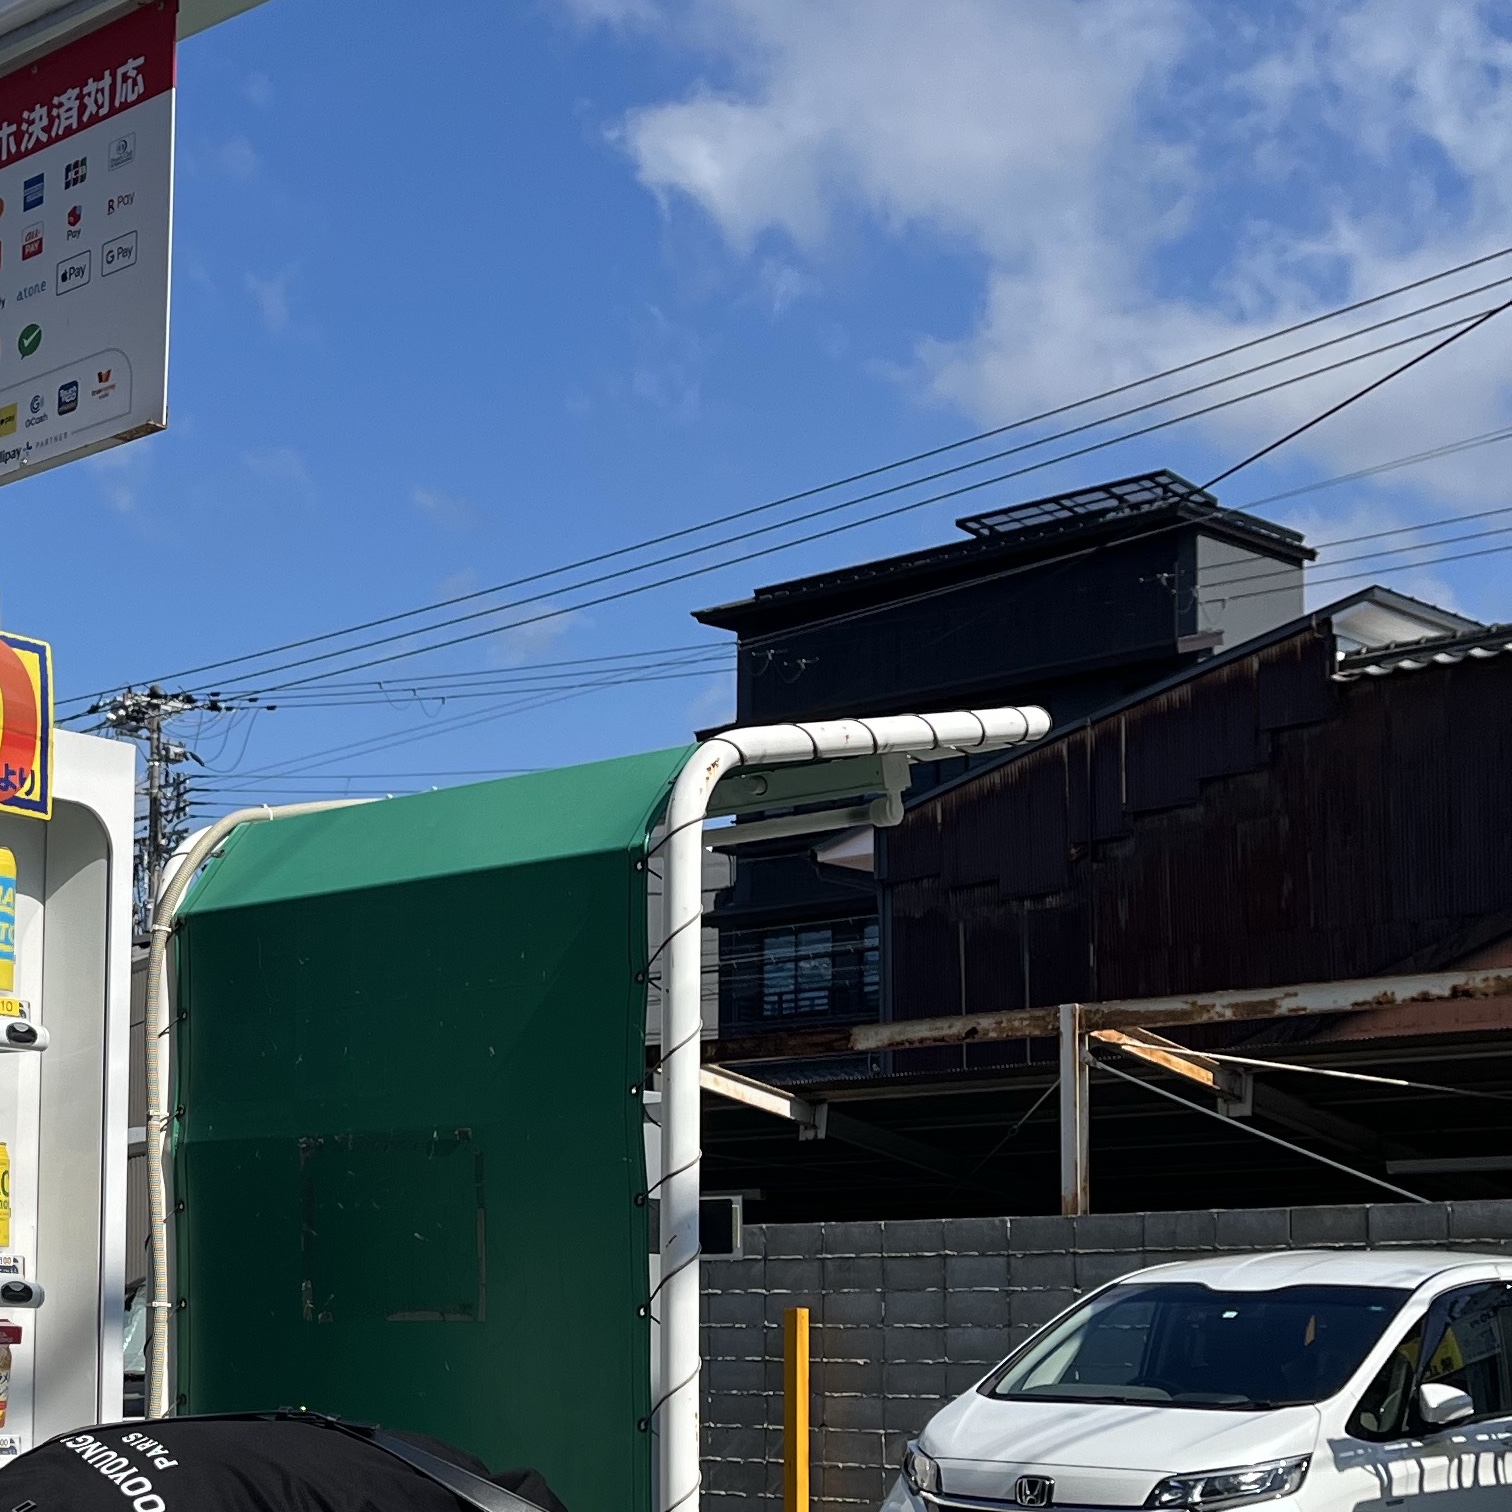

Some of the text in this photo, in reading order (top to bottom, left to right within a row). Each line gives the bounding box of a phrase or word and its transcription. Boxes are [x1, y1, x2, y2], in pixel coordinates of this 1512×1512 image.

[67, 228, 81, 241] Pay
[117, 245, 133, 260] Pay
[69, 264, 86, 280] Pay
[16, 280, 47, 301] atone
[121, 1432, 179, 1470] PARIS
